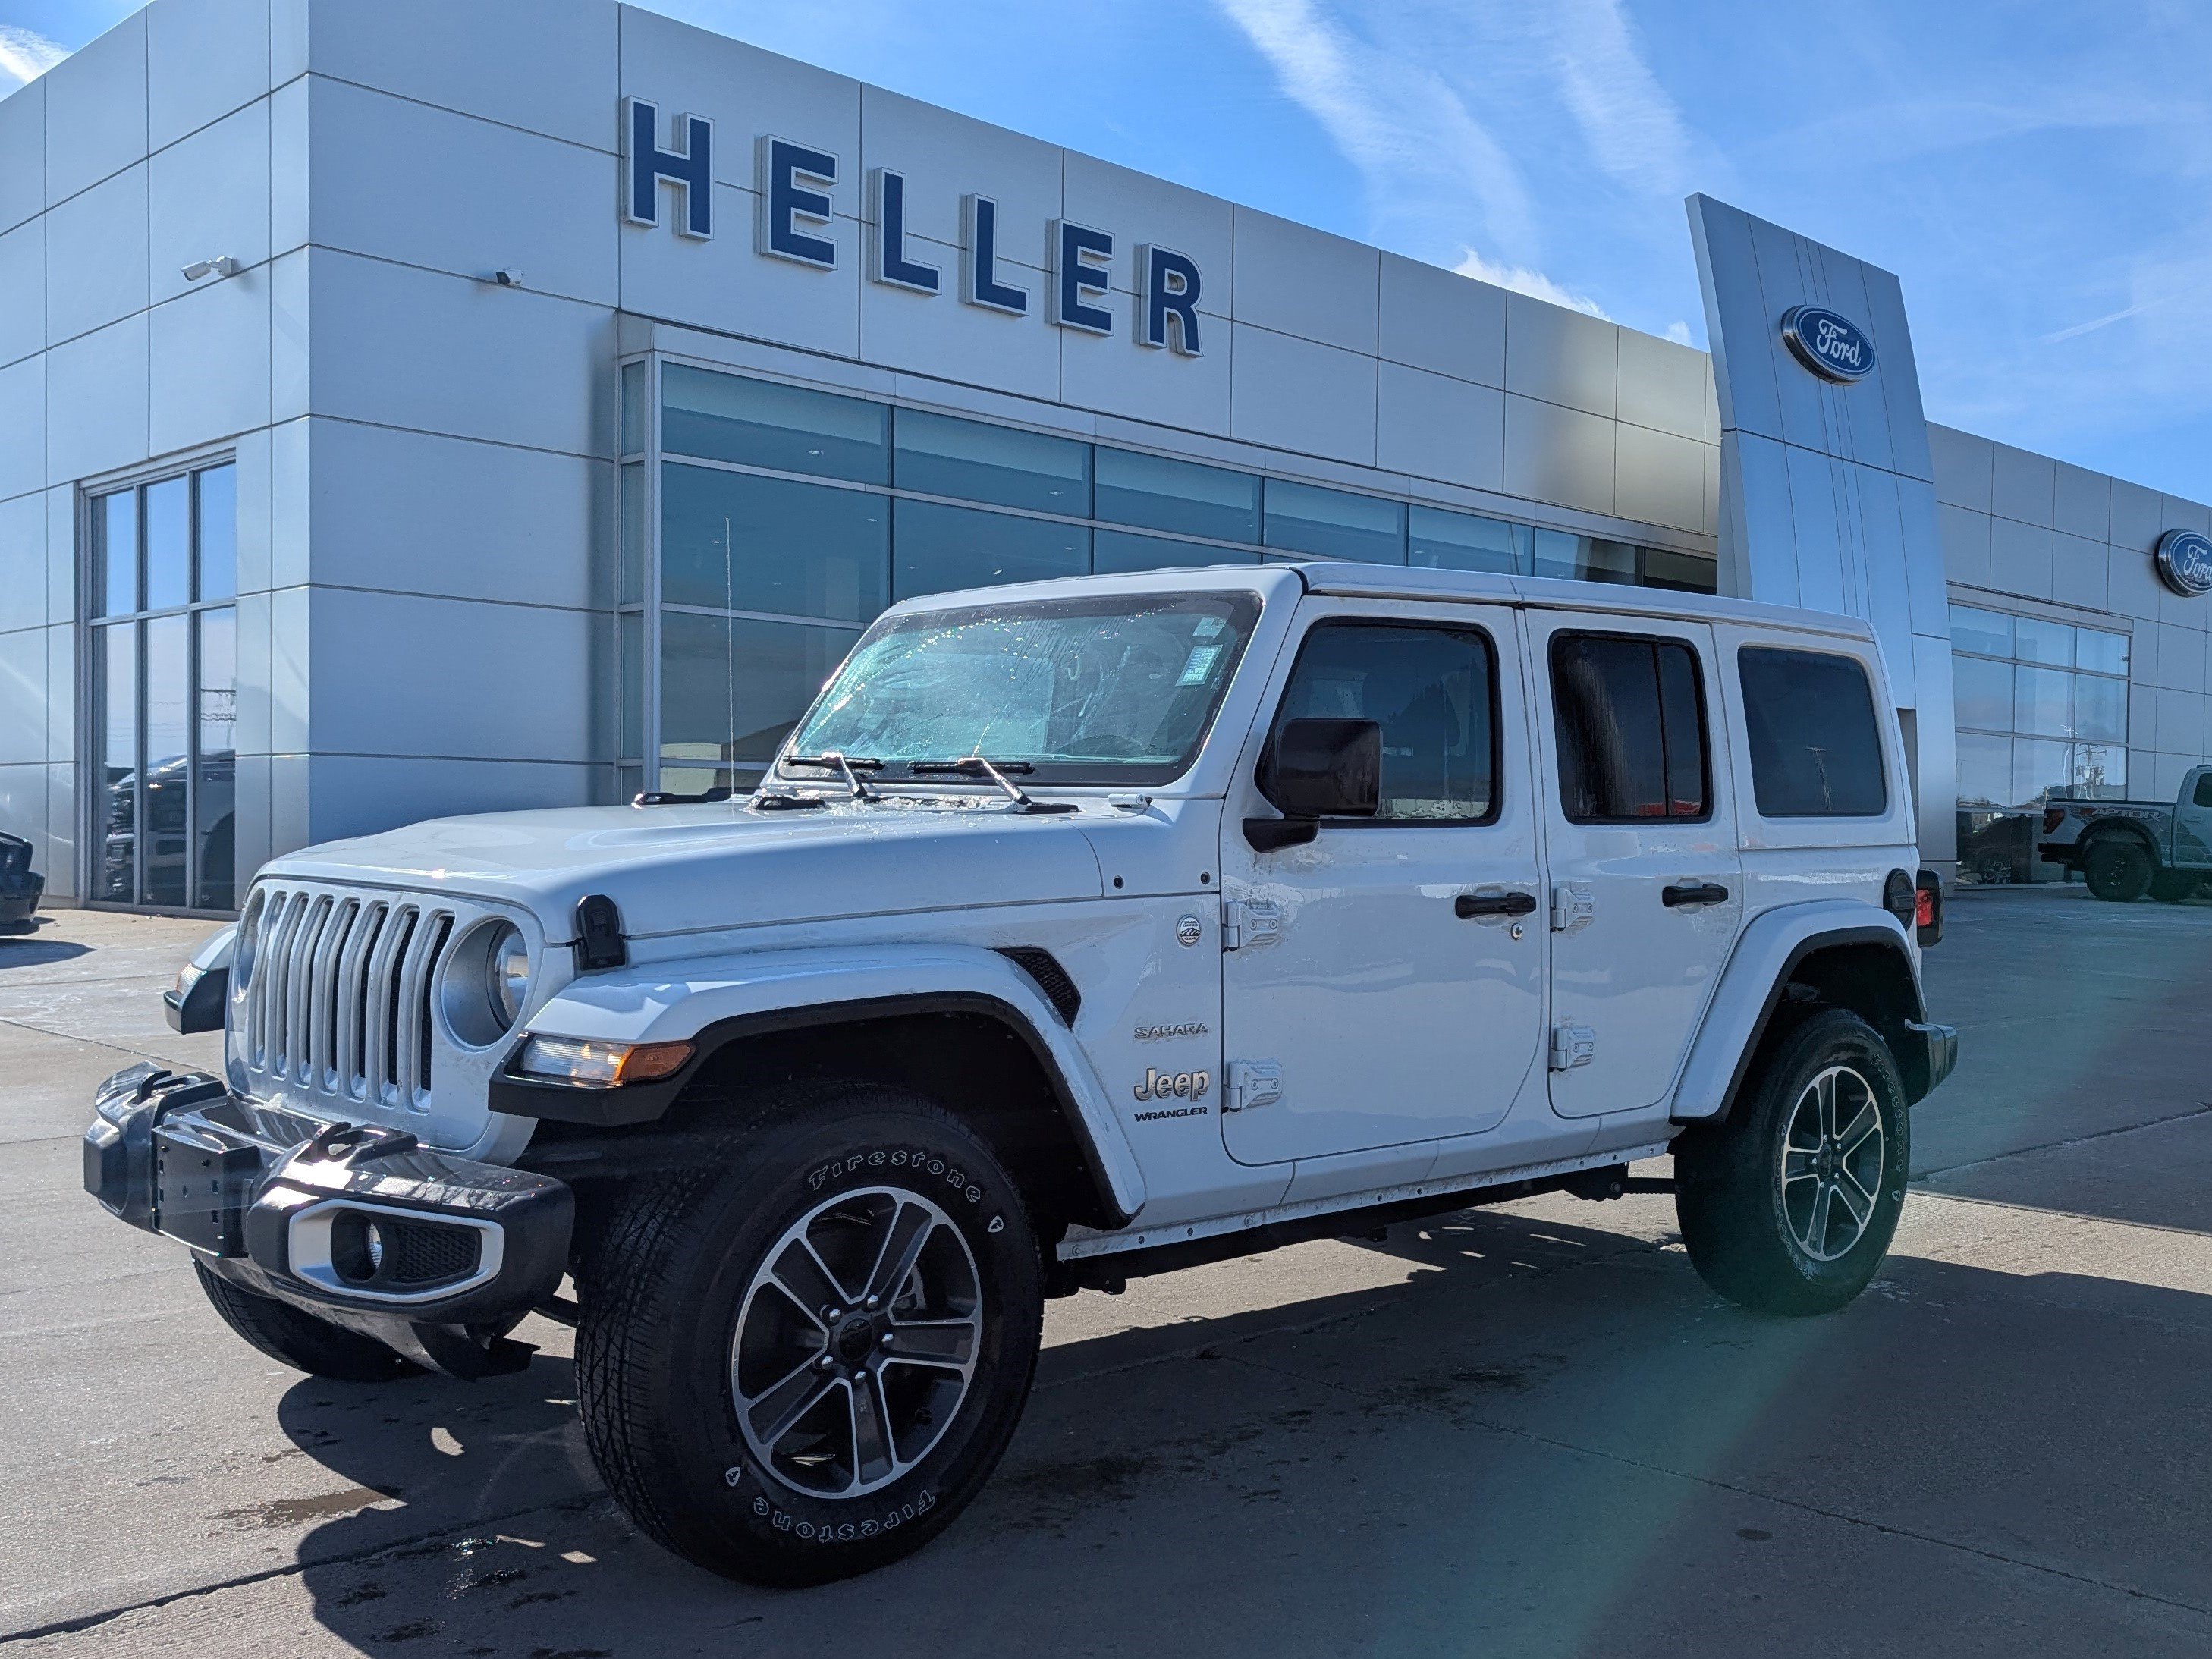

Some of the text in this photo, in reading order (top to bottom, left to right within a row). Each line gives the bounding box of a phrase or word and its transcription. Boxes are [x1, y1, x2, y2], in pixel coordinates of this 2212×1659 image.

[624, 96, 1204, 357] HELLER
[1816, 319, 1862, 366] Ford
[1134, 1023, 1208, 1040] SAHARA
[1134, 1067, 1210, 1102] Jeep
[1134, 1107, 1208, 1123] WRANGLER
[808, 1150, 982, 1203] Firestone
[753, 1489, 936, 1544] Firestone
